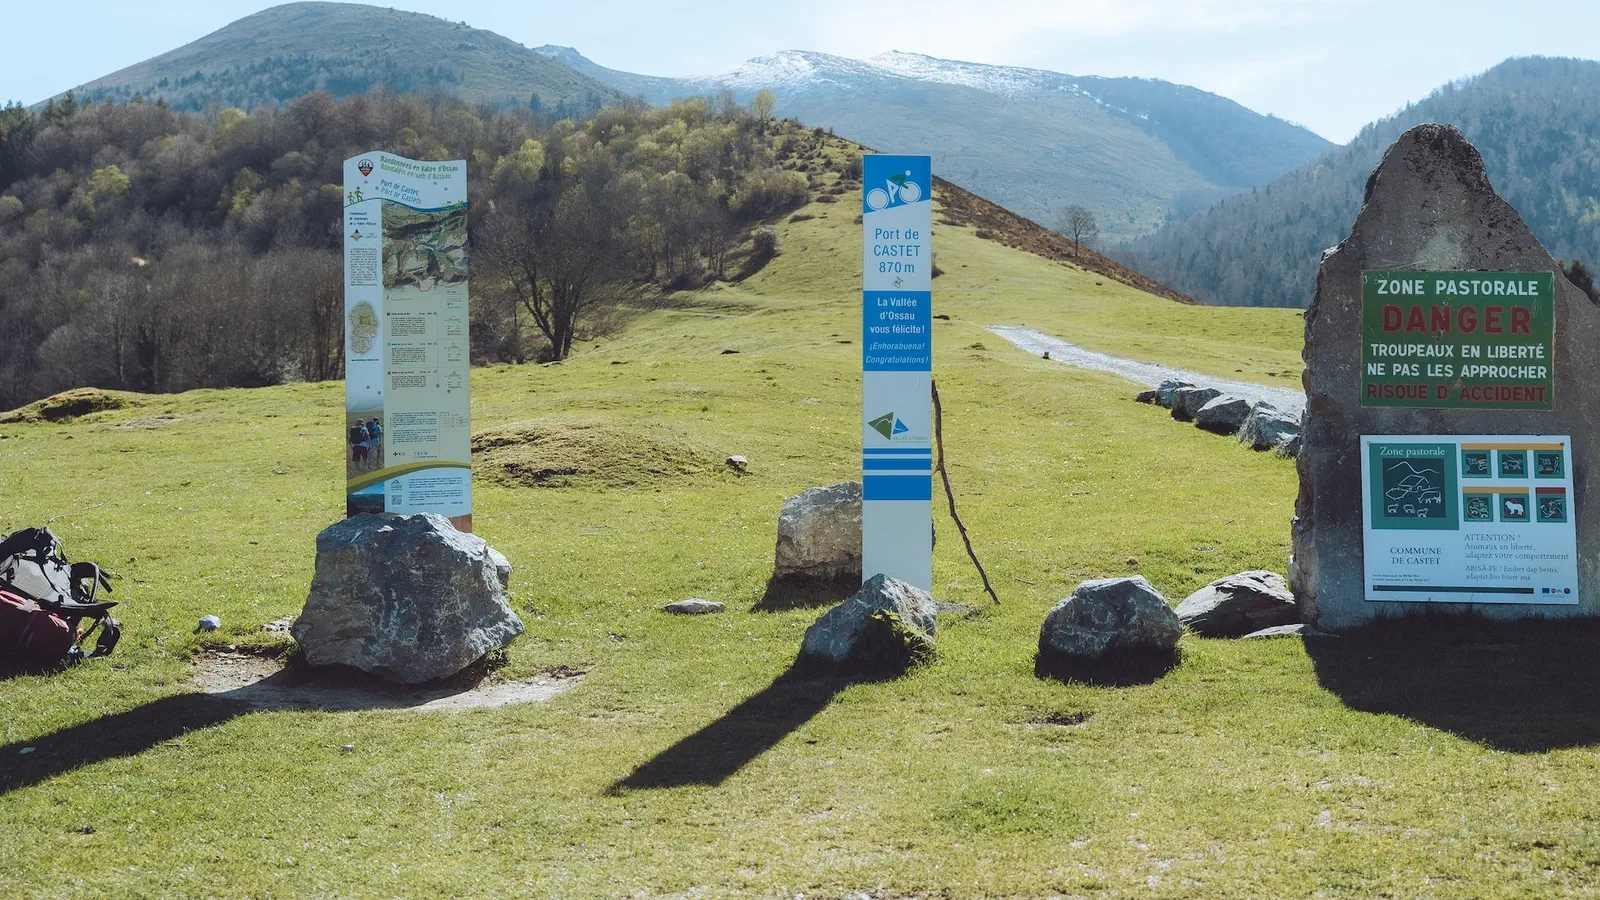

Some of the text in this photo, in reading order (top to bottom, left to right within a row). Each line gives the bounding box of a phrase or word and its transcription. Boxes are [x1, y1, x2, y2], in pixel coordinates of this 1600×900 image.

[380, 179, 393, 188] Port
[401, 185, 419, 196] Castet
[875, 228, 919, 240] Port de
[873, 245, 921, 257] CASTET
[879, 262, 902, 273] 870
[1377, 279, 1539, 296] ZONE PASTORALE
[877, 297, 917, 307] La Vallée
[880, 311, 915, 320] d'Ossau
[1382, 304, 1531, 335] DANGER
[870, 326, 890, 334] vous
[869, 342, 925, 351] ¡Enhorabuena!
[1370, 343, 1545, 359] TROUPEAUX EN LIBERTÉ
[866, 356, 929, 365] Congratulations!
[1367, 363, 1547, 379] NE PAS LES APPROCHER
[1367, 384, 1428, 400] RISQUE
[1380, 446, 1445, 458] Zone pastorale
[1390, 547, 1442, 555] COMMUNE
[1464, 551, 1492, 560] adaptez
[1515, 553, 1569, 561] comportement
[1406, 557, 1441, 565] CASTET
